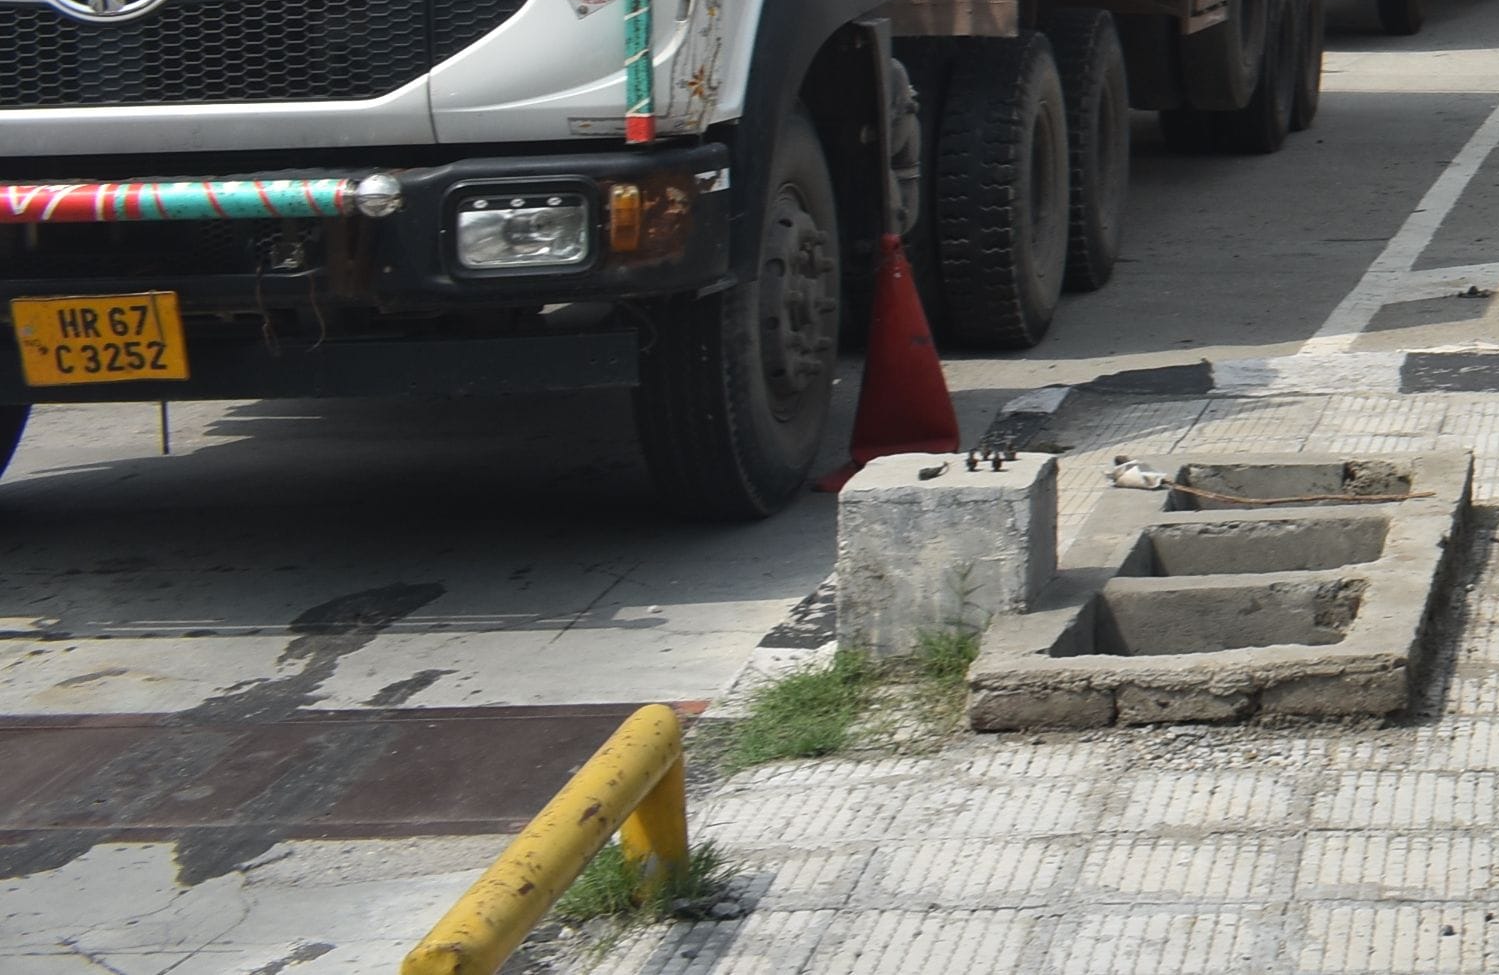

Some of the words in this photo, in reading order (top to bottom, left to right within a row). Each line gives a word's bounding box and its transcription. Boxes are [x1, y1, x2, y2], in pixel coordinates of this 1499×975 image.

[57, 307, 102, 339] HR
[108, 305, 149, 337] 67
[55, 344, 75, 374] C
[81, 341, 168, 373] 3252
